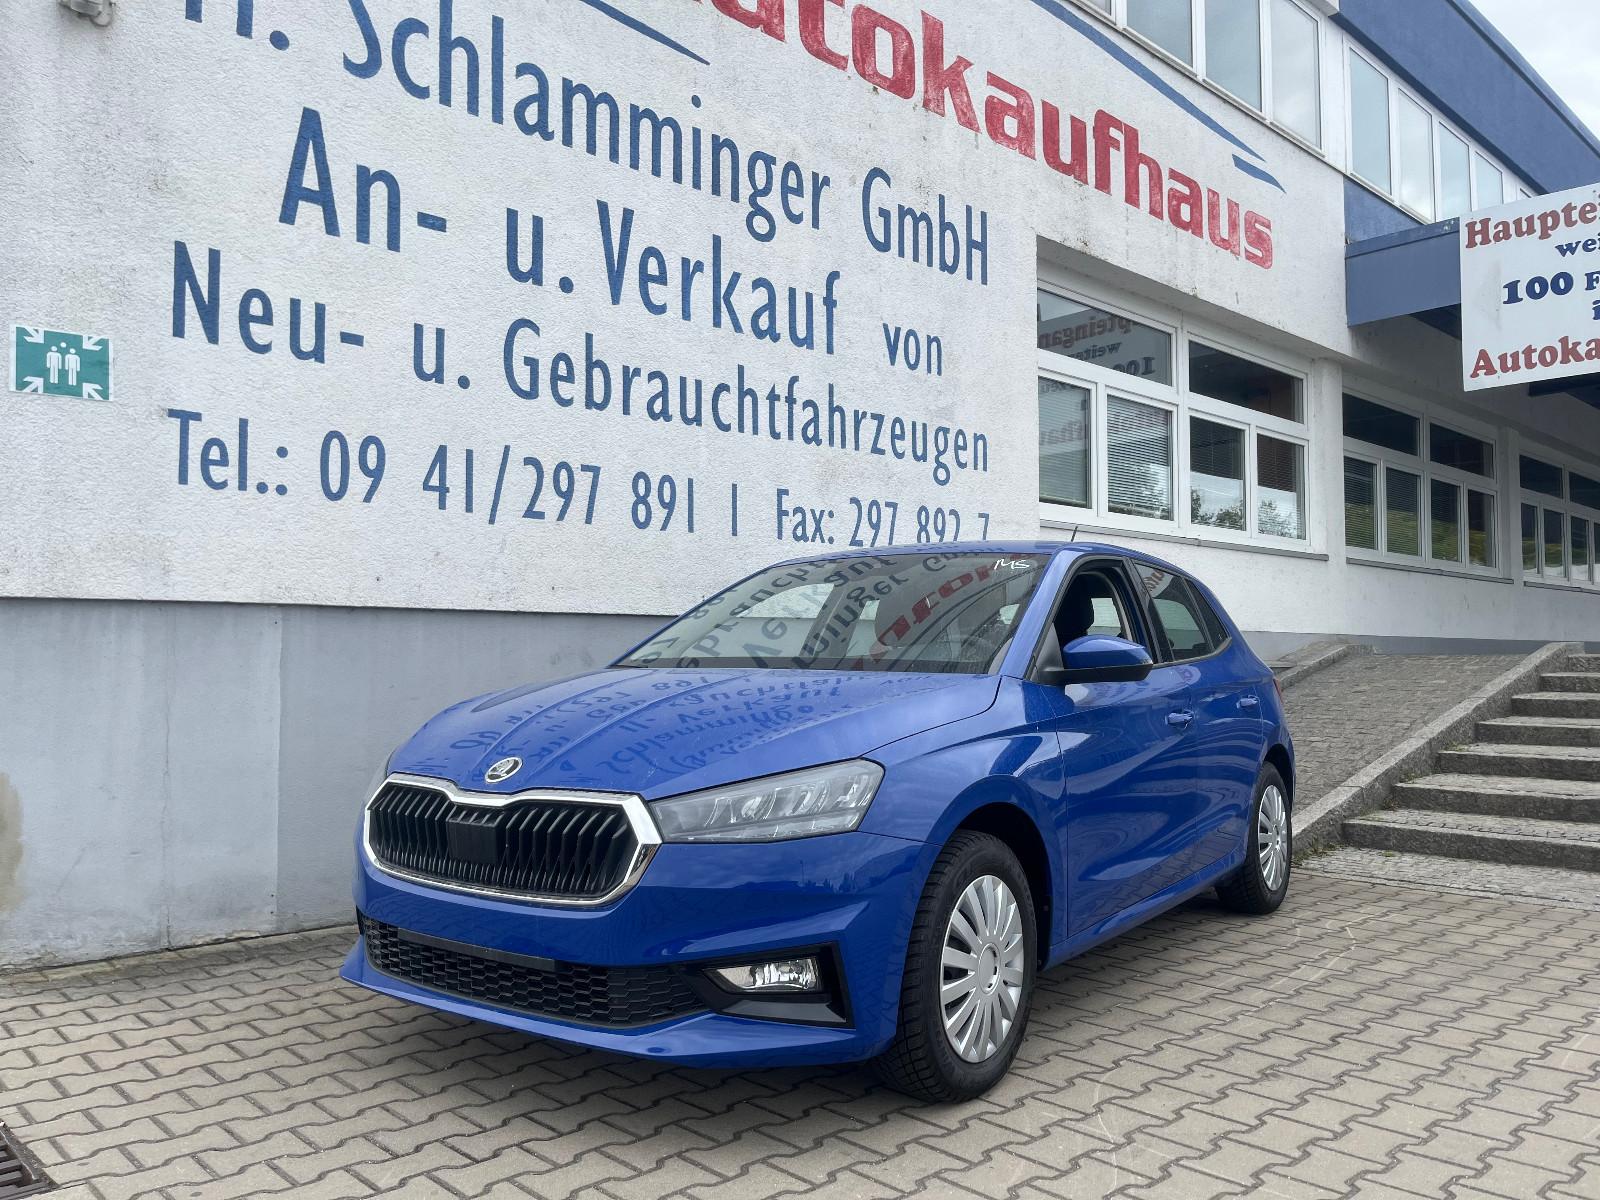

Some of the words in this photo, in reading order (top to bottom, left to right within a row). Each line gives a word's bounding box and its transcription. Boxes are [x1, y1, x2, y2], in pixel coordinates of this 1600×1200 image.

[342, 0, 831, 242] Schlamminger
[862, 168, 988, 285] GmbH
[1465, 194, 1600, 249] Haupte
[279, 107, 448, 252] An-
[506, 207, 574, 294] u.
[597, 200, 840, 354] Verkauf
[883, 323, 943, 377] von
[1503, 271, 1574, 305] 100
[172, 240, 364, 364] Neu-
[413, 322, 470, 390] u.
[503, 318, 988, 487] Gebrauchtfahrzeugen
[320, 430, 386, 503] 09
[631, 471, 694, 533] 891
[776, 487, 835, 545] Fax:
[850, 496, 898, 547] 297
